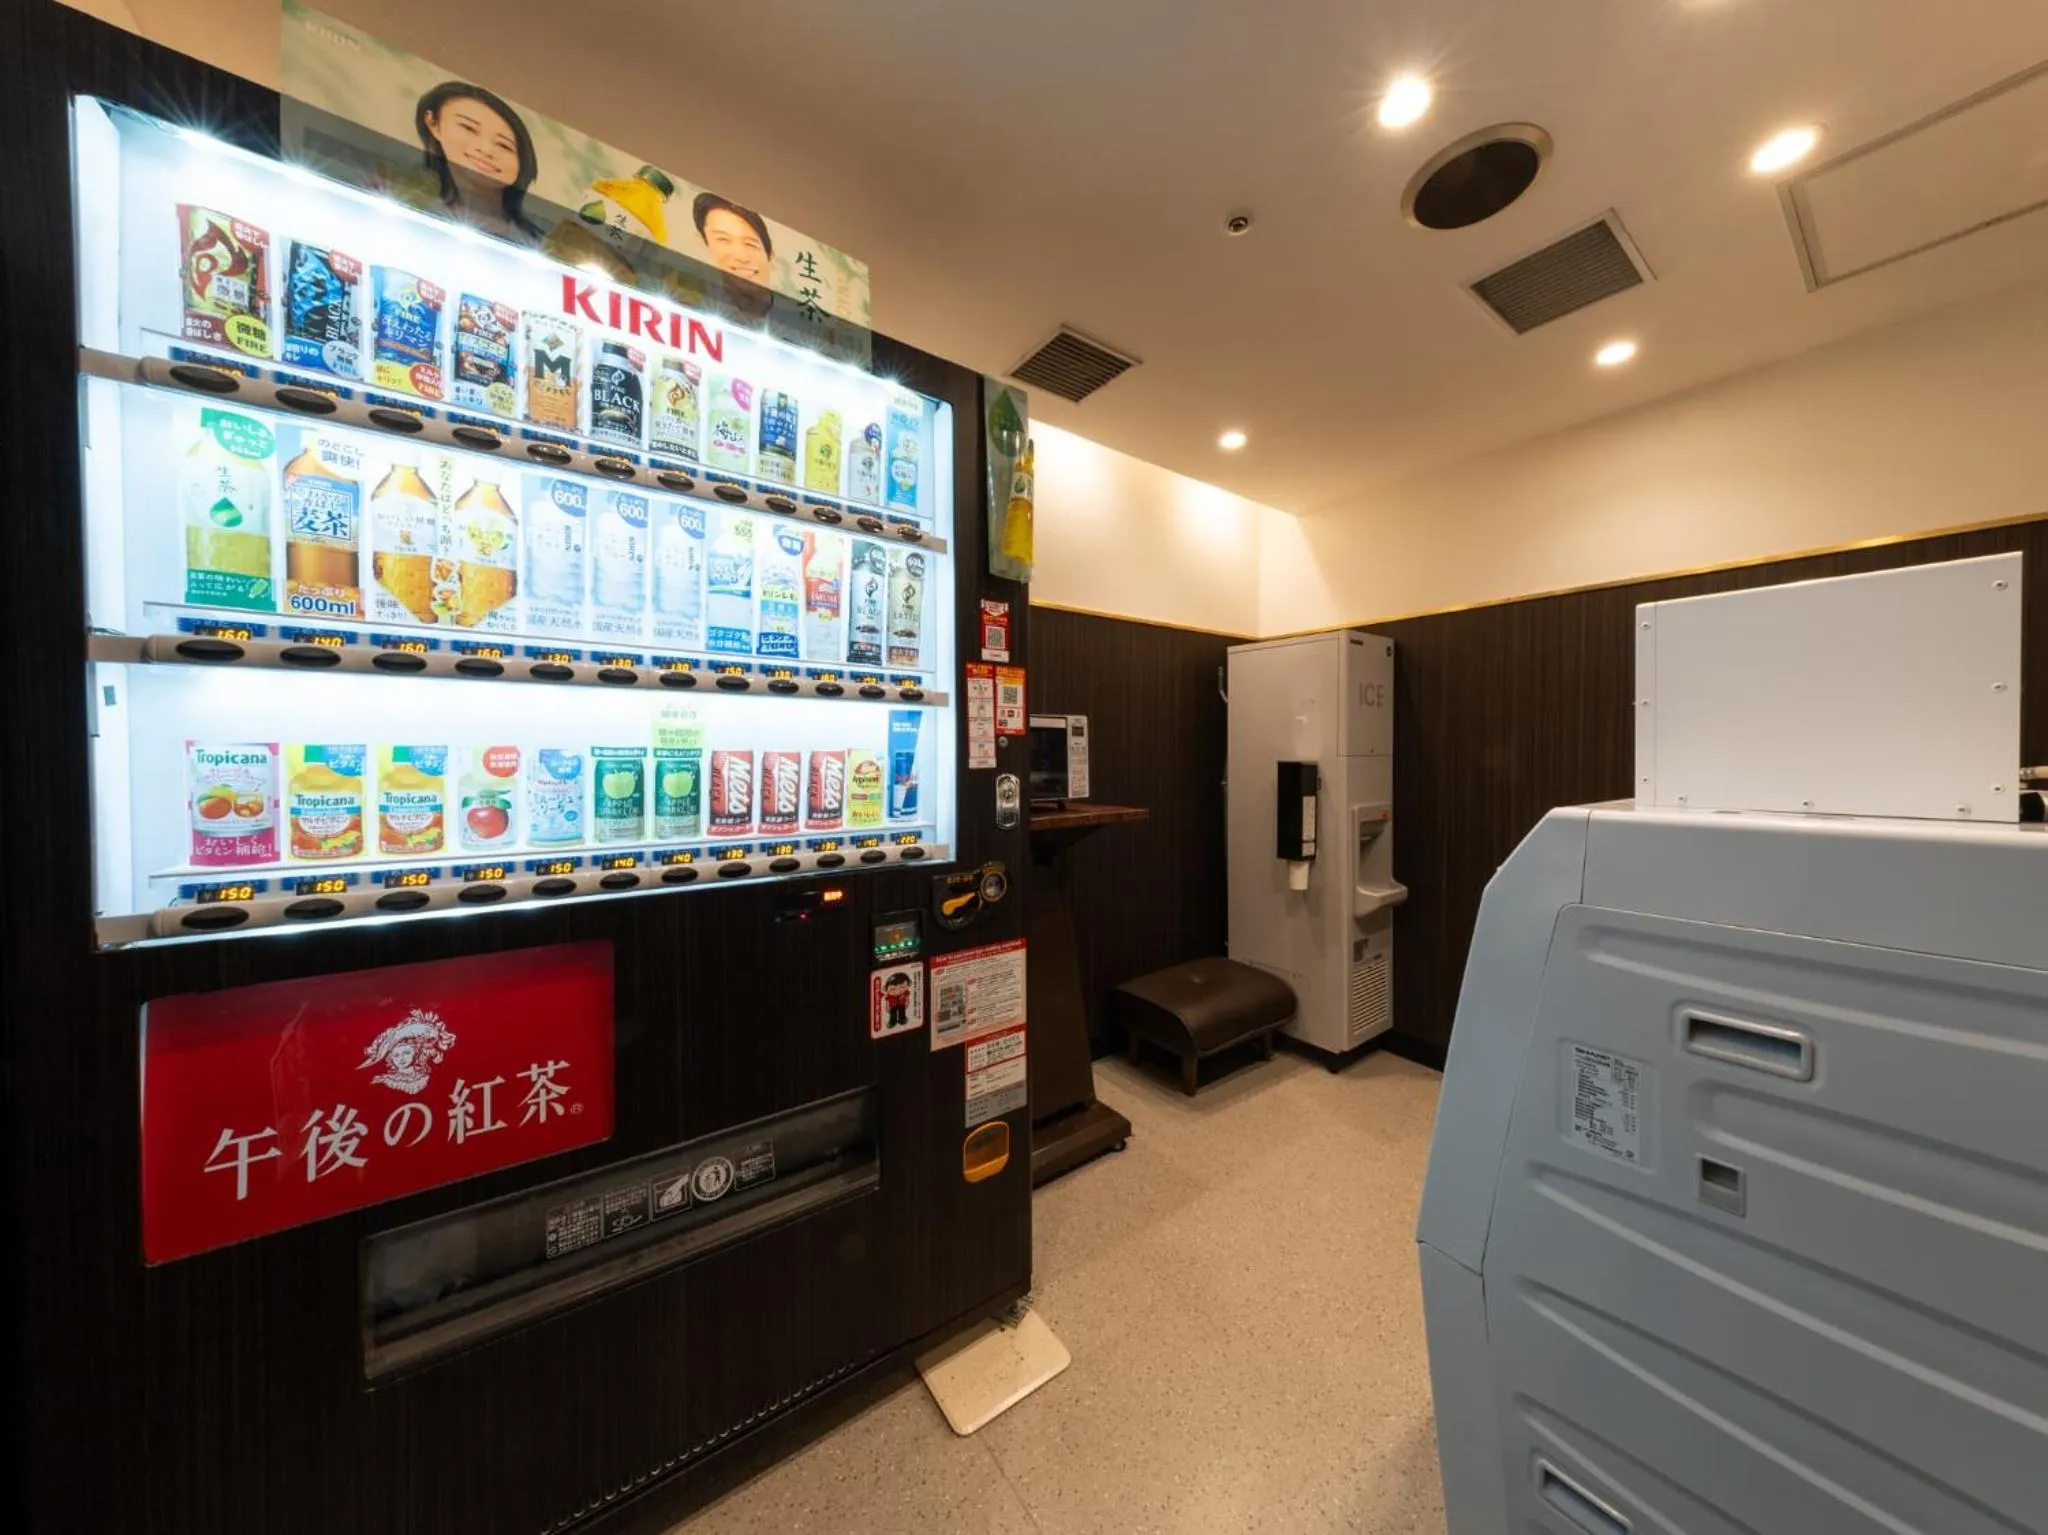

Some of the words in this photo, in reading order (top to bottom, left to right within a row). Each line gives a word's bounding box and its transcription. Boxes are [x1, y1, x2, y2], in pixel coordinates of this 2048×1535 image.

[796, 252, 826, 323] 生茶
[326, 300, 343, 340] BLACK
[563, 274, 723, 362] KIRIN
[236, 337, 268, 352] FIRE
[593, 388, 641, 413] BLACK
[317, 438, 366, 457] のどこし
[217, 465, 239, 494] 生茶
[296, 506, 350, 537] 麦茶
[290, 596, 355, 616] 600ml
[217, 630, 249, 641] 160
[400, 643, 425, 654] 160
[478, 648, 500, 658] 160
[1359, 683, 1385, 708] ICE
[196, 748, 269, 765] Tropicana
[295, 794, 356, 809] Tropicana
[383, 792, 438, 806] Tropicana
[551, 863, 571, 873] 150
[614, 858, 634, 868] 140
[403, 874, 428, 886] 150
[480, 868, 503, 879] 150
[220, 886, 252, 901] 150
[316, 880, 344, 893] 150
[204, 1061, 561, 1200] 午後の紅茶
